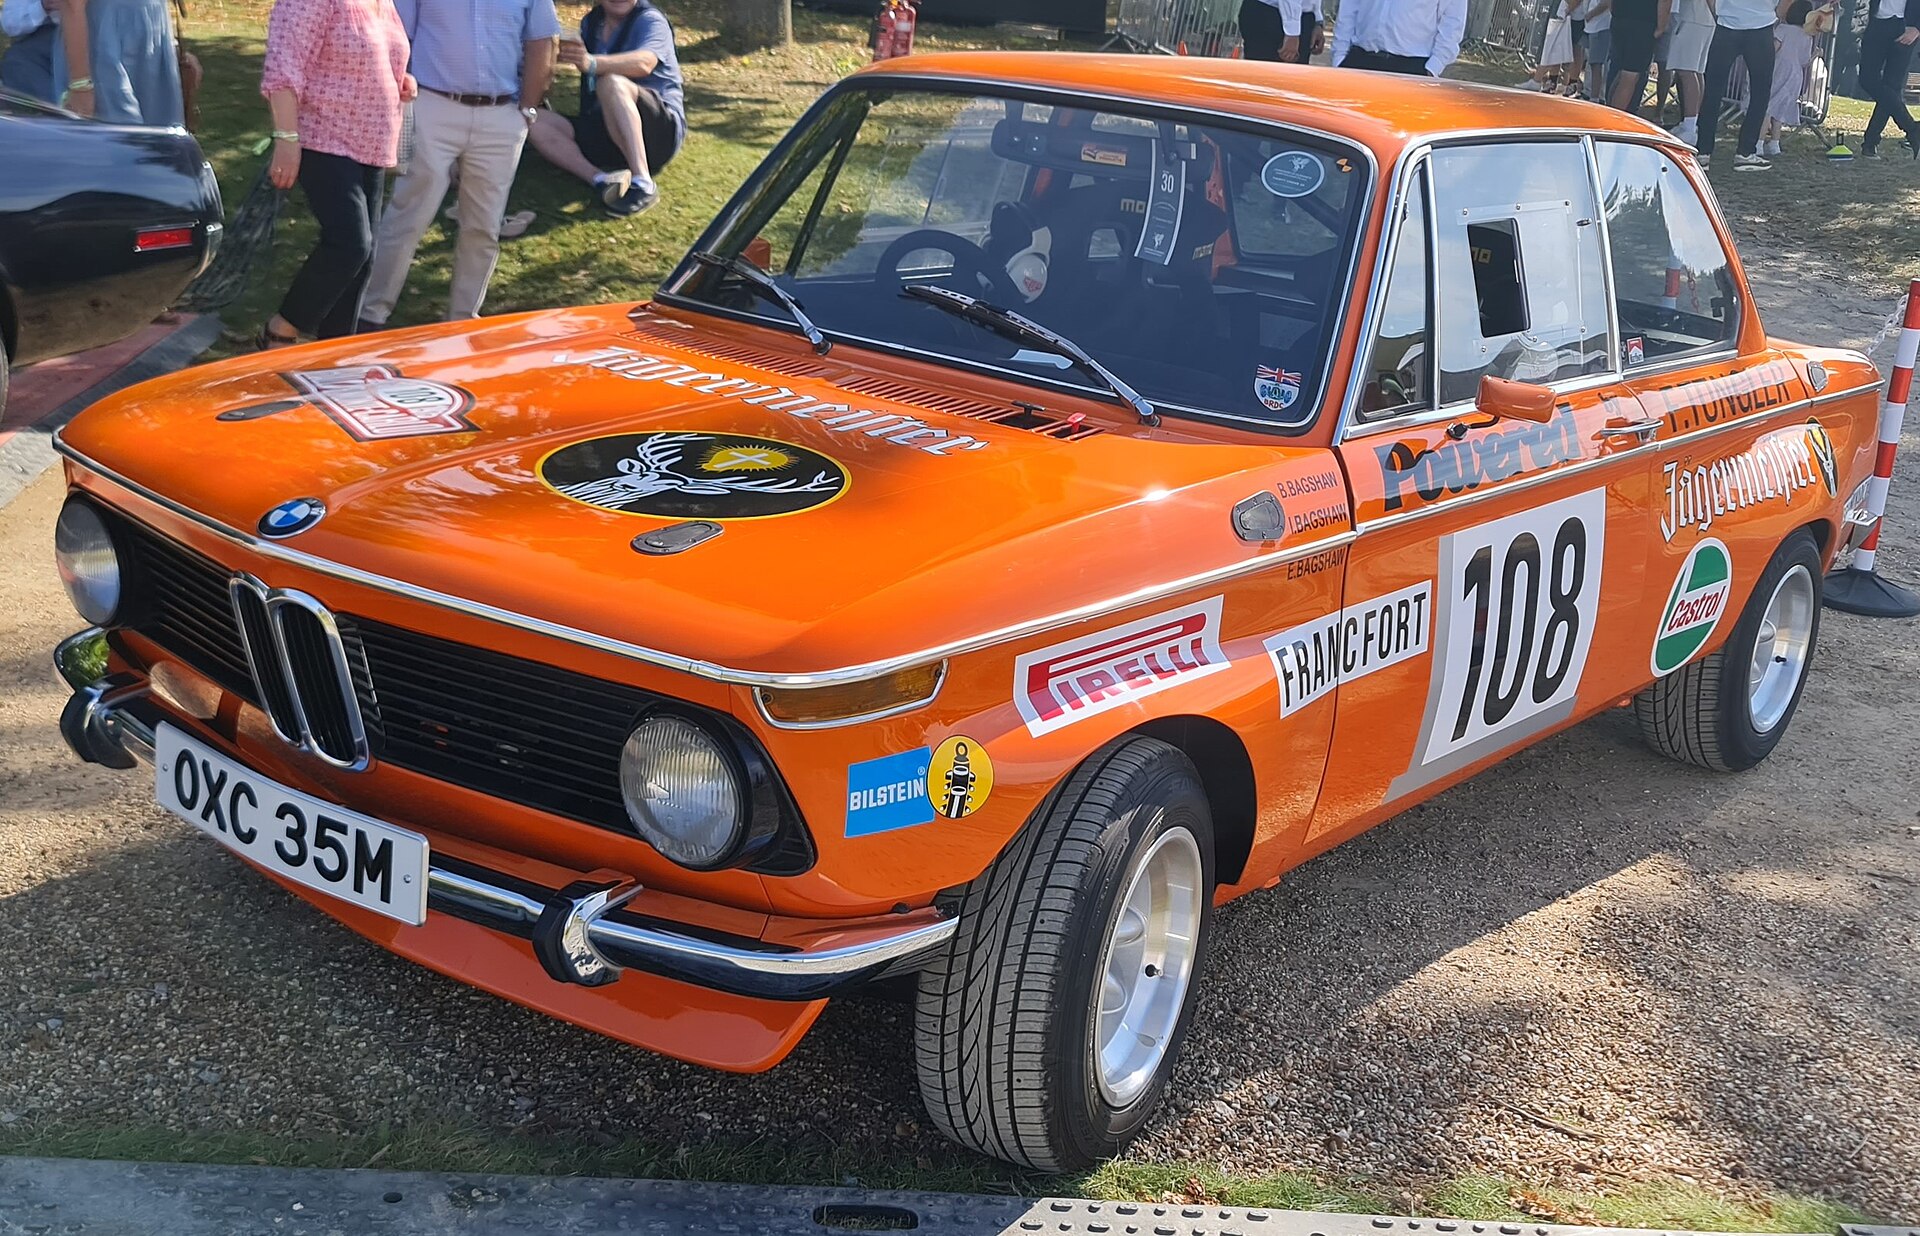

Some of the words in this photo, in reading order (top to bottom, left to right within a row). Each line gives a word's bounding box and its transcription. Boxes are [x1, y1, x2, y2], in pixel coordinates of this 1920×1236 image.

[1160, 173, 1175, 194] 30
[1263, 398, 1285, 409] BRDC
[1374, 402, 1582, 512] Powered
[1276, 471, 1338, 499] B.BAGSHAW
[1660, 434, 1816, 543] Jägermeister
[1288, 503, 1348, 535] I.BAGSHAW
[1287, 548, 1346, 580] E.BAGSHAW
[1450, 516, 1588, 743] 108
[1667, 585, 1727, 632] Castrol
[1027, 612, 1210, 722] PIRELLI
[1275, 591, 1428, 709] FRANCFORT
[849, 777, 924, 811] BILSTEIN
[174, 748, 258, 845] OXC
[274, 801, 394, 905] 35M
